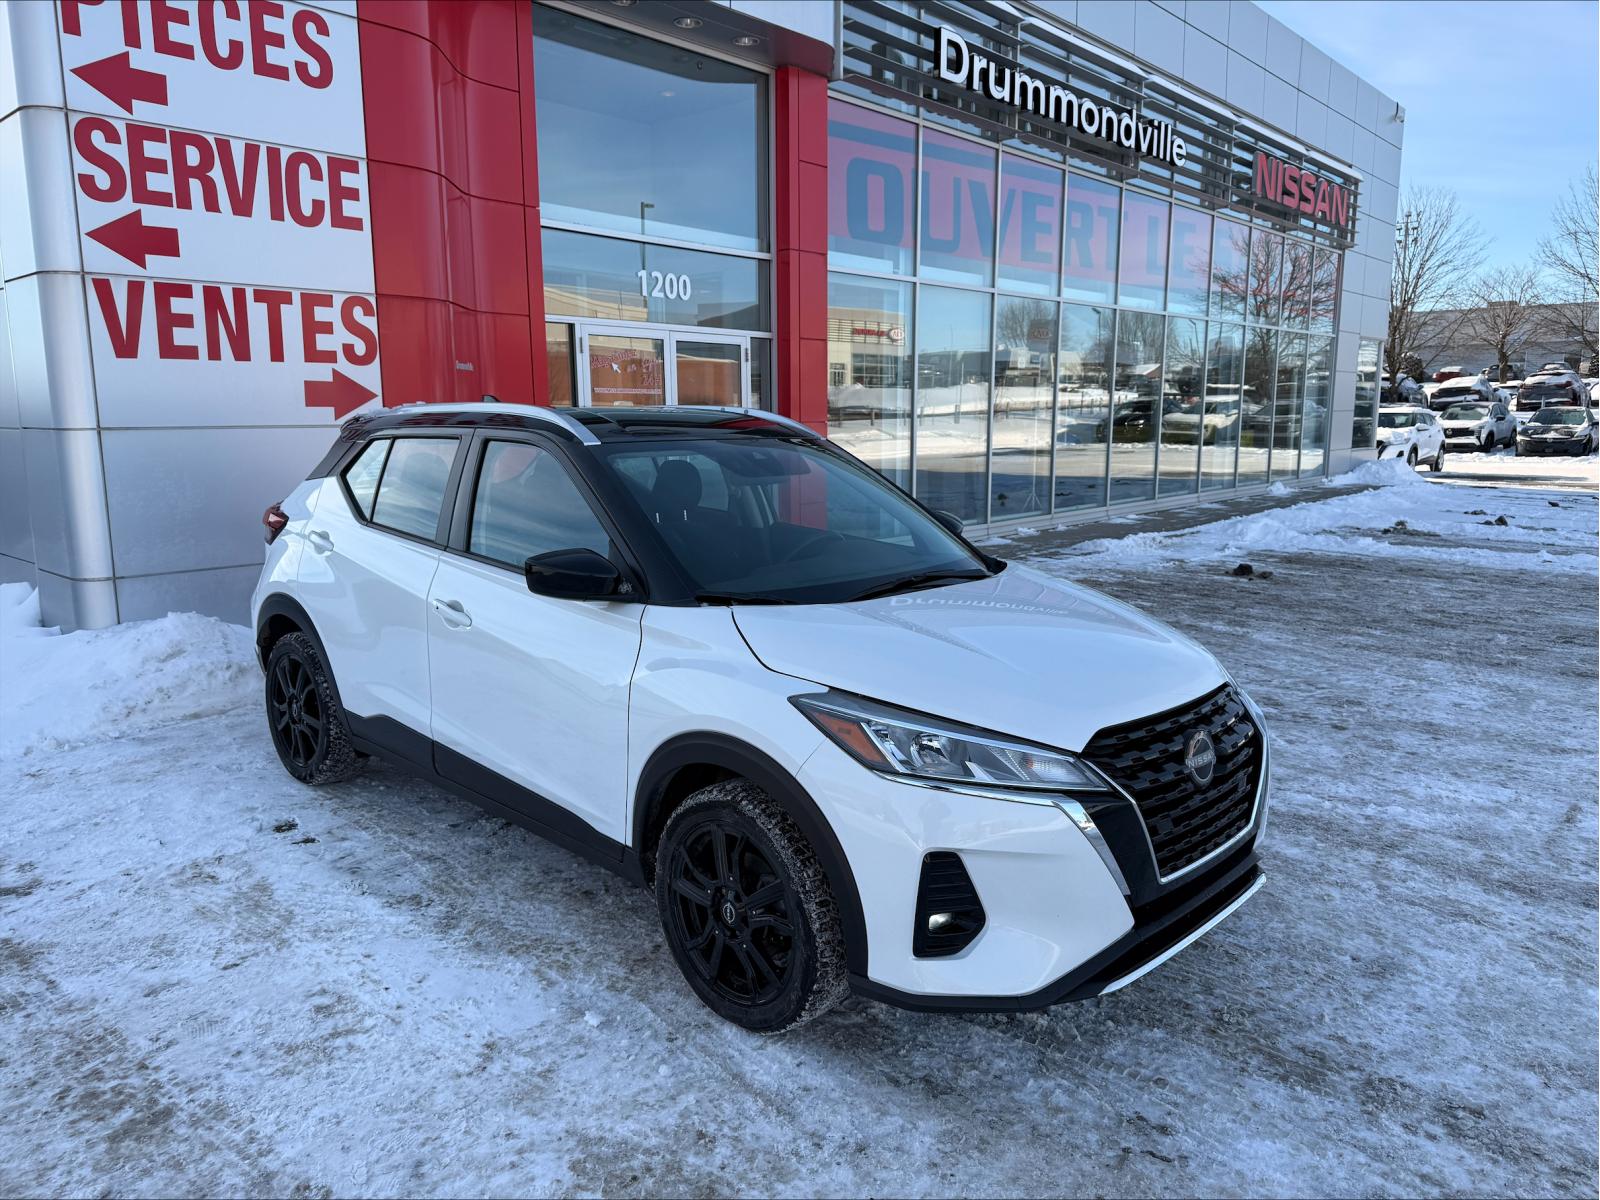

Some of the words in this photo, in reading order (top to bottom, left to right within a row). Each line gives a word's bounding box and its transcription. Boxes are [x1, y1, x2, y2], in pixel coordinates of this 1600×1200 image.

[940, 26, 1187, 168] Drummondville
[73, 116, 364, 232] SERVICE
[846, 157, 1128, 272] OUVERT
[1254, 152, 1349, 227] NISSAN
[92, 278, 378, 365] VENTES
[637, 270, 692, 300] 1200
[1186, 750, 1215, 768] NISSAN
